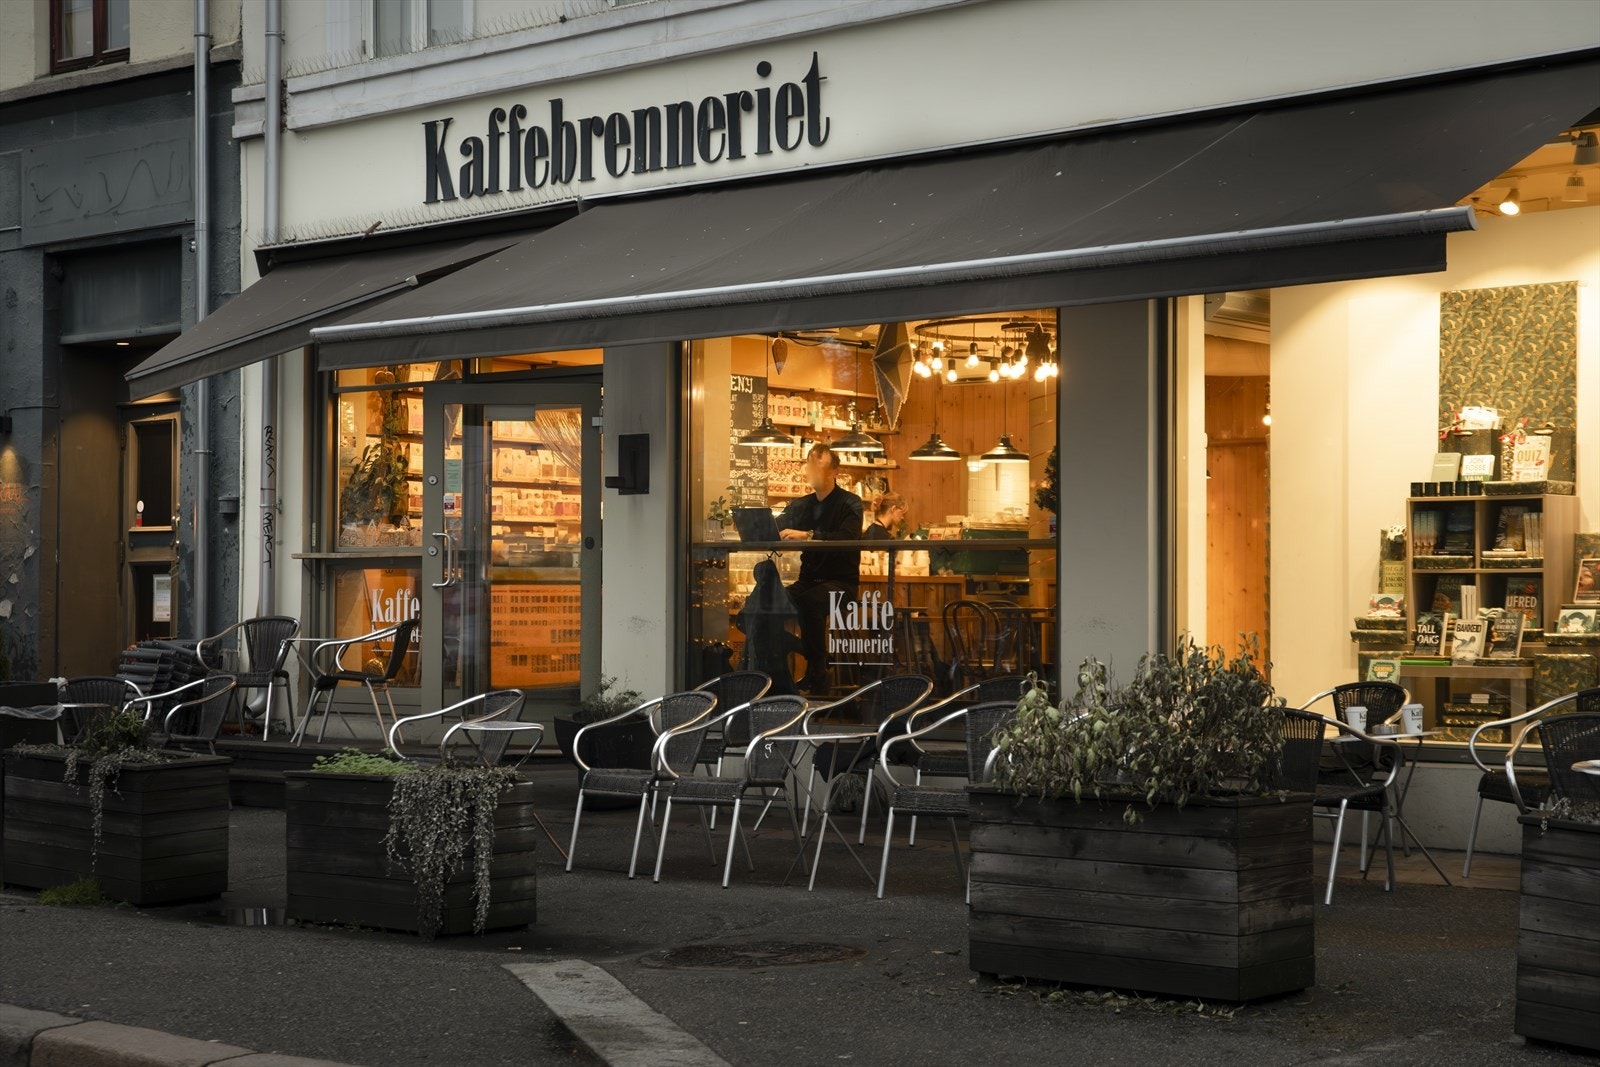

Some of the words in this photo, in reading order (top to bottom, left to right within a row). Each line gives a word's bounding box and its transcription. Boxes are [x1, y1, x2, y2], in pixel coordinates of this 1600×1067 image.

[422, 51, 830, 204] Kaffebrenneriet
[1517, 449, 1542, 463] QUIZ
[371, 588, 420, 622] Kaffe
[1506, 595, 1537, 608] UFRED
[828, 590, 894, 631] Kaffe
[1417, 624, 1436, 634] TALL
[828, 633, 894, 654] brenneriet
[1417, 634, 1440, 645] OAKS
